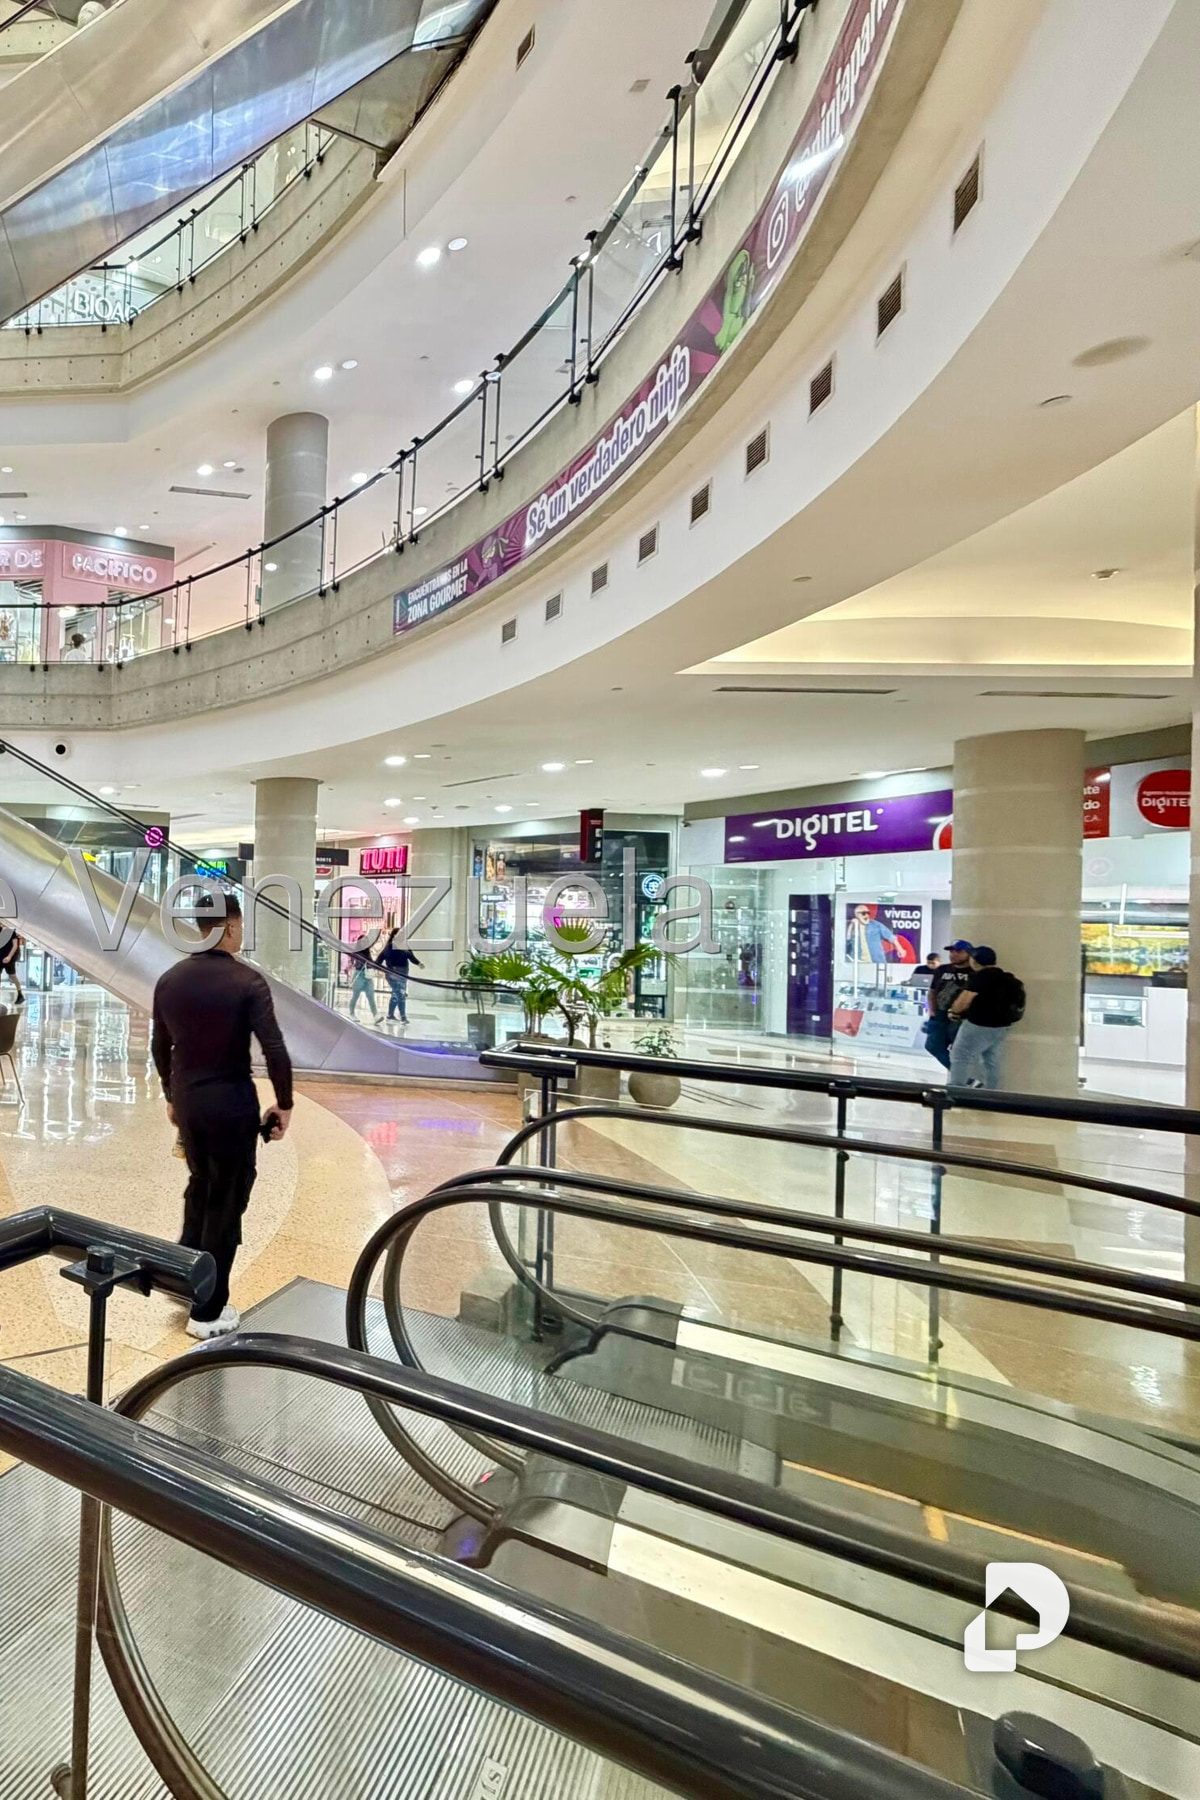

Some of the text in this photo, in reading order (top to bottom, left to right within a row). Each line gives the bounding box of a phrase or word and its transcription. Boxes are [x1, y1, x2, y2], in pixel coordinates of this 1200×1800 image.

[527, 348, 688, 539] Sé un verdadero ninja
[15, 549, 44, 568] DE
[461, 558, 468, 574] LA
[407, 598, 428, 624] ZONA
[429, 574, 468, 612] GOURMET
[891, 920, 921, 930] TODO
